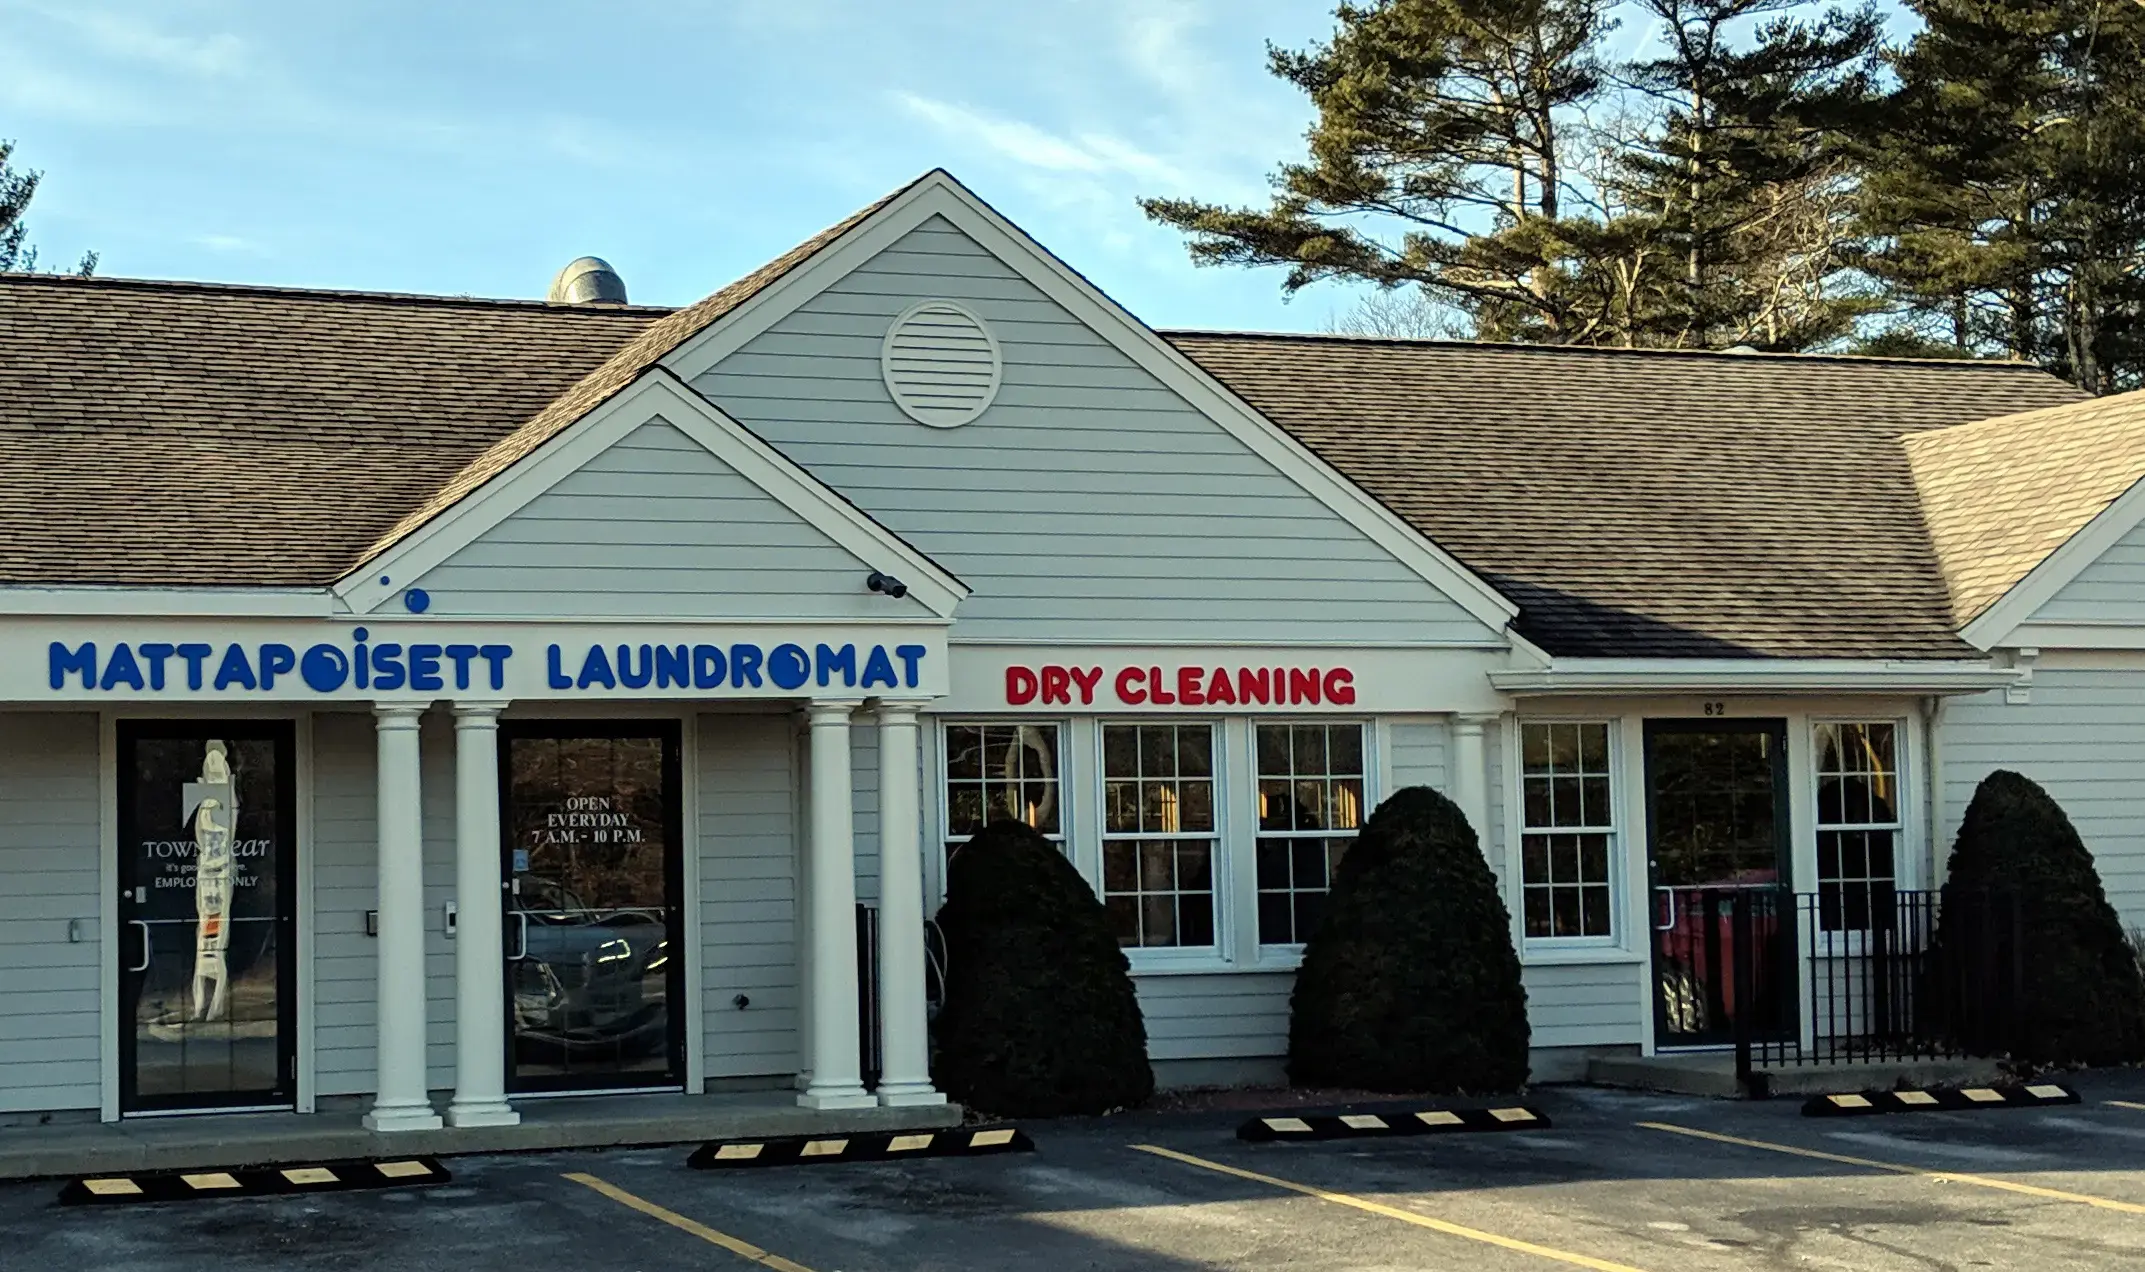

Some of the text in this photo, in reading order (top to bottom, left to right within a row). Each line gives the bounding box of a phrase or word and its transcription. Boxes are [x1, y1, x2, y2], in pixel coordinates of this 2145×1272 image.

[547, 643, 926, 690] LAUNDROMAT
[1005, 666, 1356, 706] DRY CLEANING
[1704, 702, 1725, 716] 82
[566, 797, 610, 810] OPEN
[548, 813, 630, 828] EVERYDAY
[531, 830, 541, 843] 7
[594, 830, 608, 843] 10
[613, 829, 646, 843] P.M.
